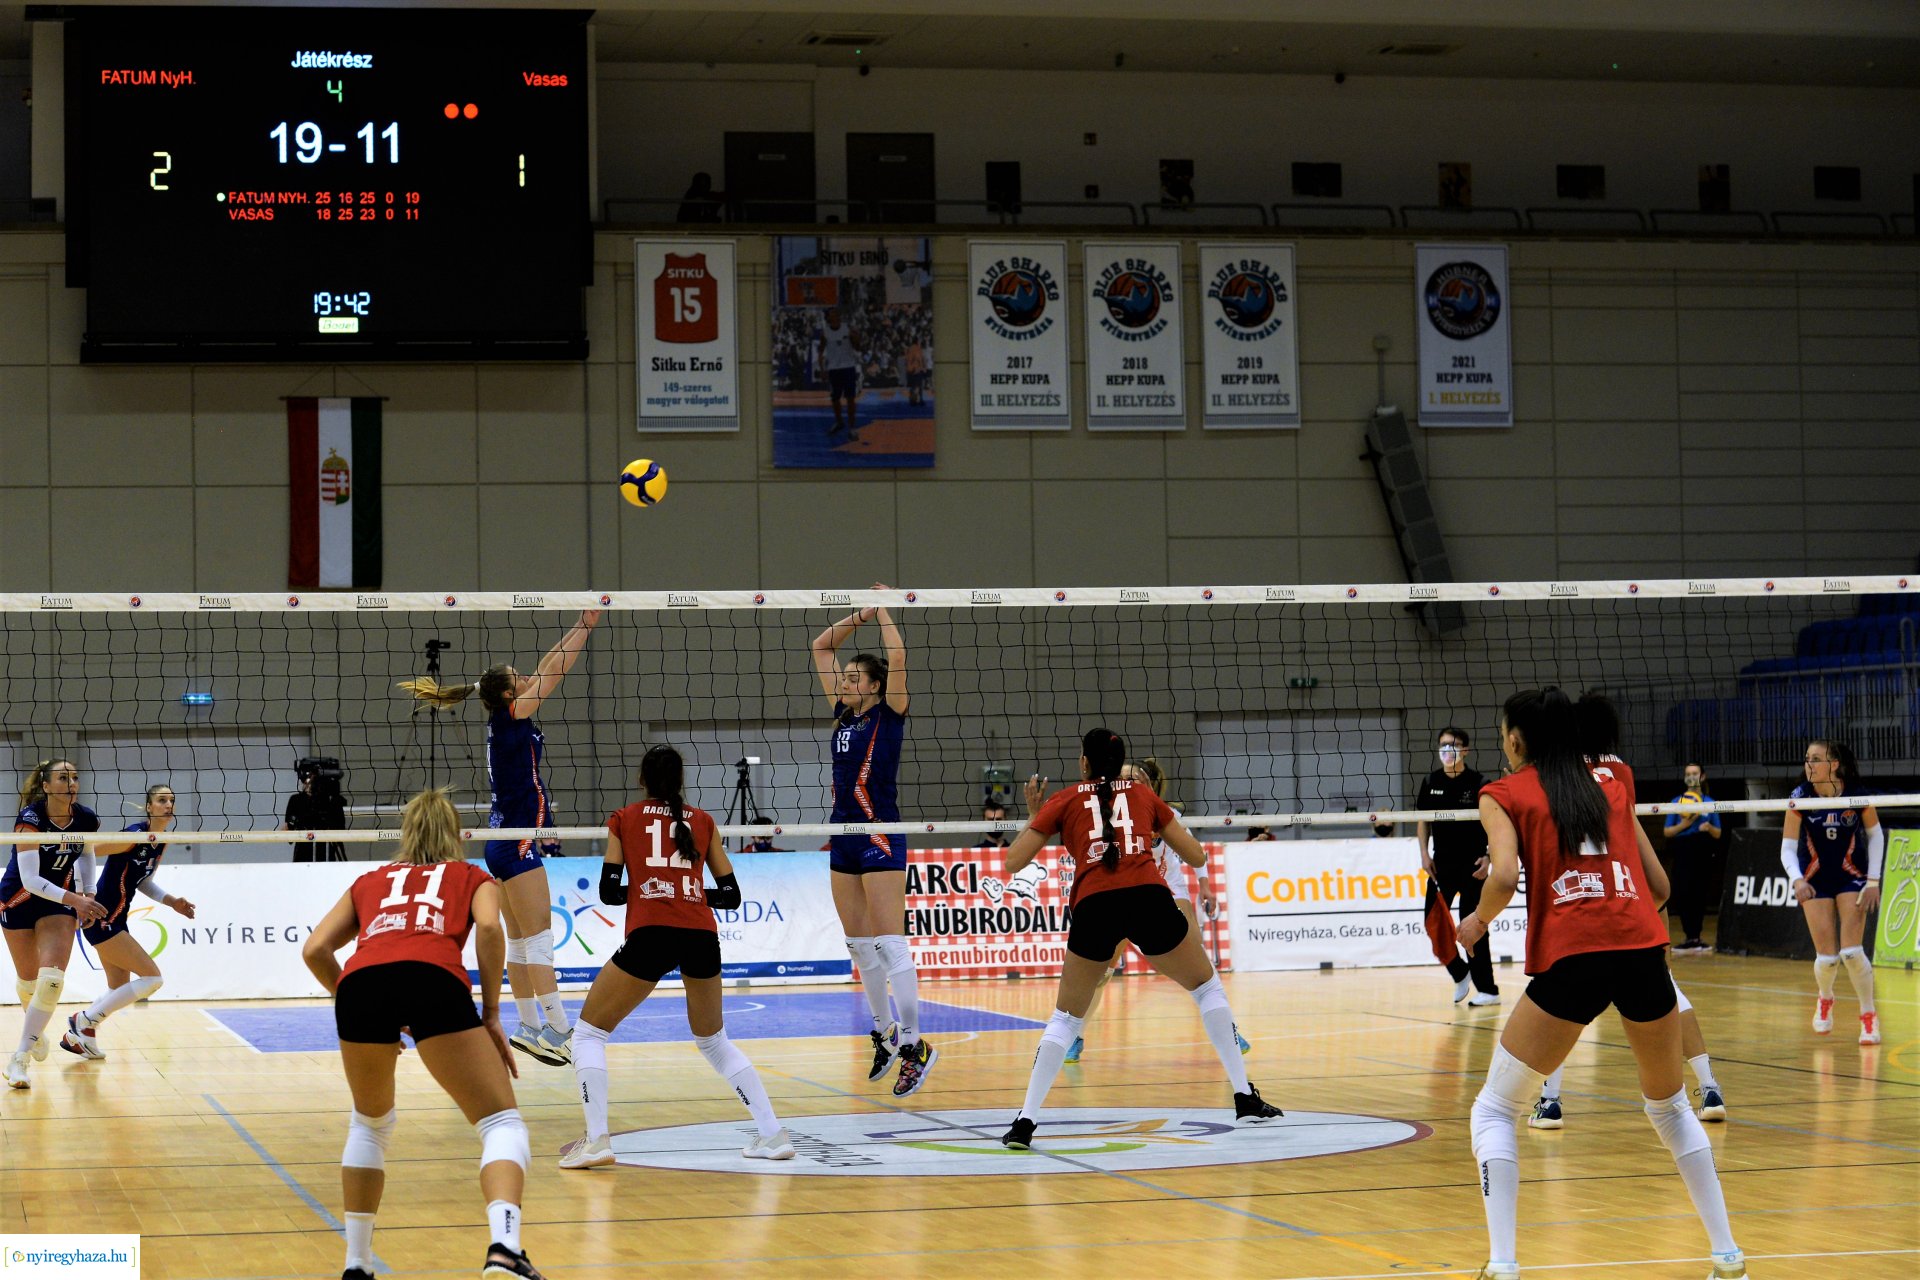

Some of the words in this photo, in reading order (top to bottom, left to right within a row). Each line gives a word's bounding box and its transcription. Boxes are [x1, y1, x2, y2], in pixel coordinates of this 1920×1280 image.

[291, 51, 373, 68] Játékrész
[102, 70, 156, 85] FATUM
[161, 71, 196, 88] NyH.
[523, 72, 568, 86] Vasas
[327, 80, 342, 102] 4
[150, 152, 171, 190] 2
[518, 154, 526, 187] 1
[229, 192, 275, 204] FATUM
[278, 192, 310, 204] NYH.
[316, 192, 331, 204] 25
[339, 192, 353, 204] 16
[360, 192, 375, 204] 25
[386, 192, 394, 204] 0
[406, 192, 420, 204] 19
[229, 208, 274, 220] VASAS
[317, 208, 331, 220] 18
[338, 208, 353, 220] 25
[360, 208, 375, 220] 23
[386, 208, 394, 220] 0
[406, 208, 419, 220] 11
[667, 268, 704, 279] SITKU
[977, 260, 1007, 297] BLUE
[1011, 257, 1059, 301] SHARKS
[1093, 262, 1122, 298] BLUE
[1126, 259, 1173, 302] SHARKS
[1208, 263, 1236, 298] BLUE
[1240, 260, 1288, 302] SHARKS
[314, 292, 370, 315] 19:42
[670, 287, 703, 323] 15
[652, 357, 686, 371] Sitku
[690, 357, 722, 371] Ernő
[1007, 357, 1032, 368] 2017
[1123, 357, 1148, 369] 2018
[1237, 357, 1263, 369] 2019
[1452, 356, 1476, 368] 2021
[990, 374, 1018, 384] HEPP
[1022, 374, 1050, 384] KUPA
[1106, 375, 1134, 385] HEPP
[1137, 375, 1165, 385] KUPA
[1221, 374, 1249, 384] HEPP
[1252, 374, 1280, 384] KUPA
[1436, 373, 1463, 383] HEPP
[1466, 373, 1493, 383] KUPA
[647, 397, 681, 407] magyar
[997, 391, 1061, 406] HELYEZÉS
[1113, 391, 1176, 407] HELYEZÉS
[1228, 390, 1290, 406] HELYEZÉS
[1083, 793, 1133, 840] 14
[1826, 827, 1837, 840] 6
[645, 819, 692, 868] 12
[52, 855, 69, 870] 11
[380, 863, 446, 909] 11
[905, 863, 978, 894] ARCI
[1246, 868, 1430, 904] Continent
[713, 900, 784, 923] ABDA
[905, 903, 1072, 935] ENÜBIRODAL
[720, 928, 742, 941] SÉG
[1250, 926, 1336, 944] Nyíregyháza,
[1340, 924, 1372, 937] Géza
[1376, 927, 1388, 936] u.
[1391, 922, 1424, 935] 8-16.
[1493, 920, 1509, 932] 30
[912, 945, 1065, 965] .menubirodalom
[787, 965, 814, 973] hunvolley
